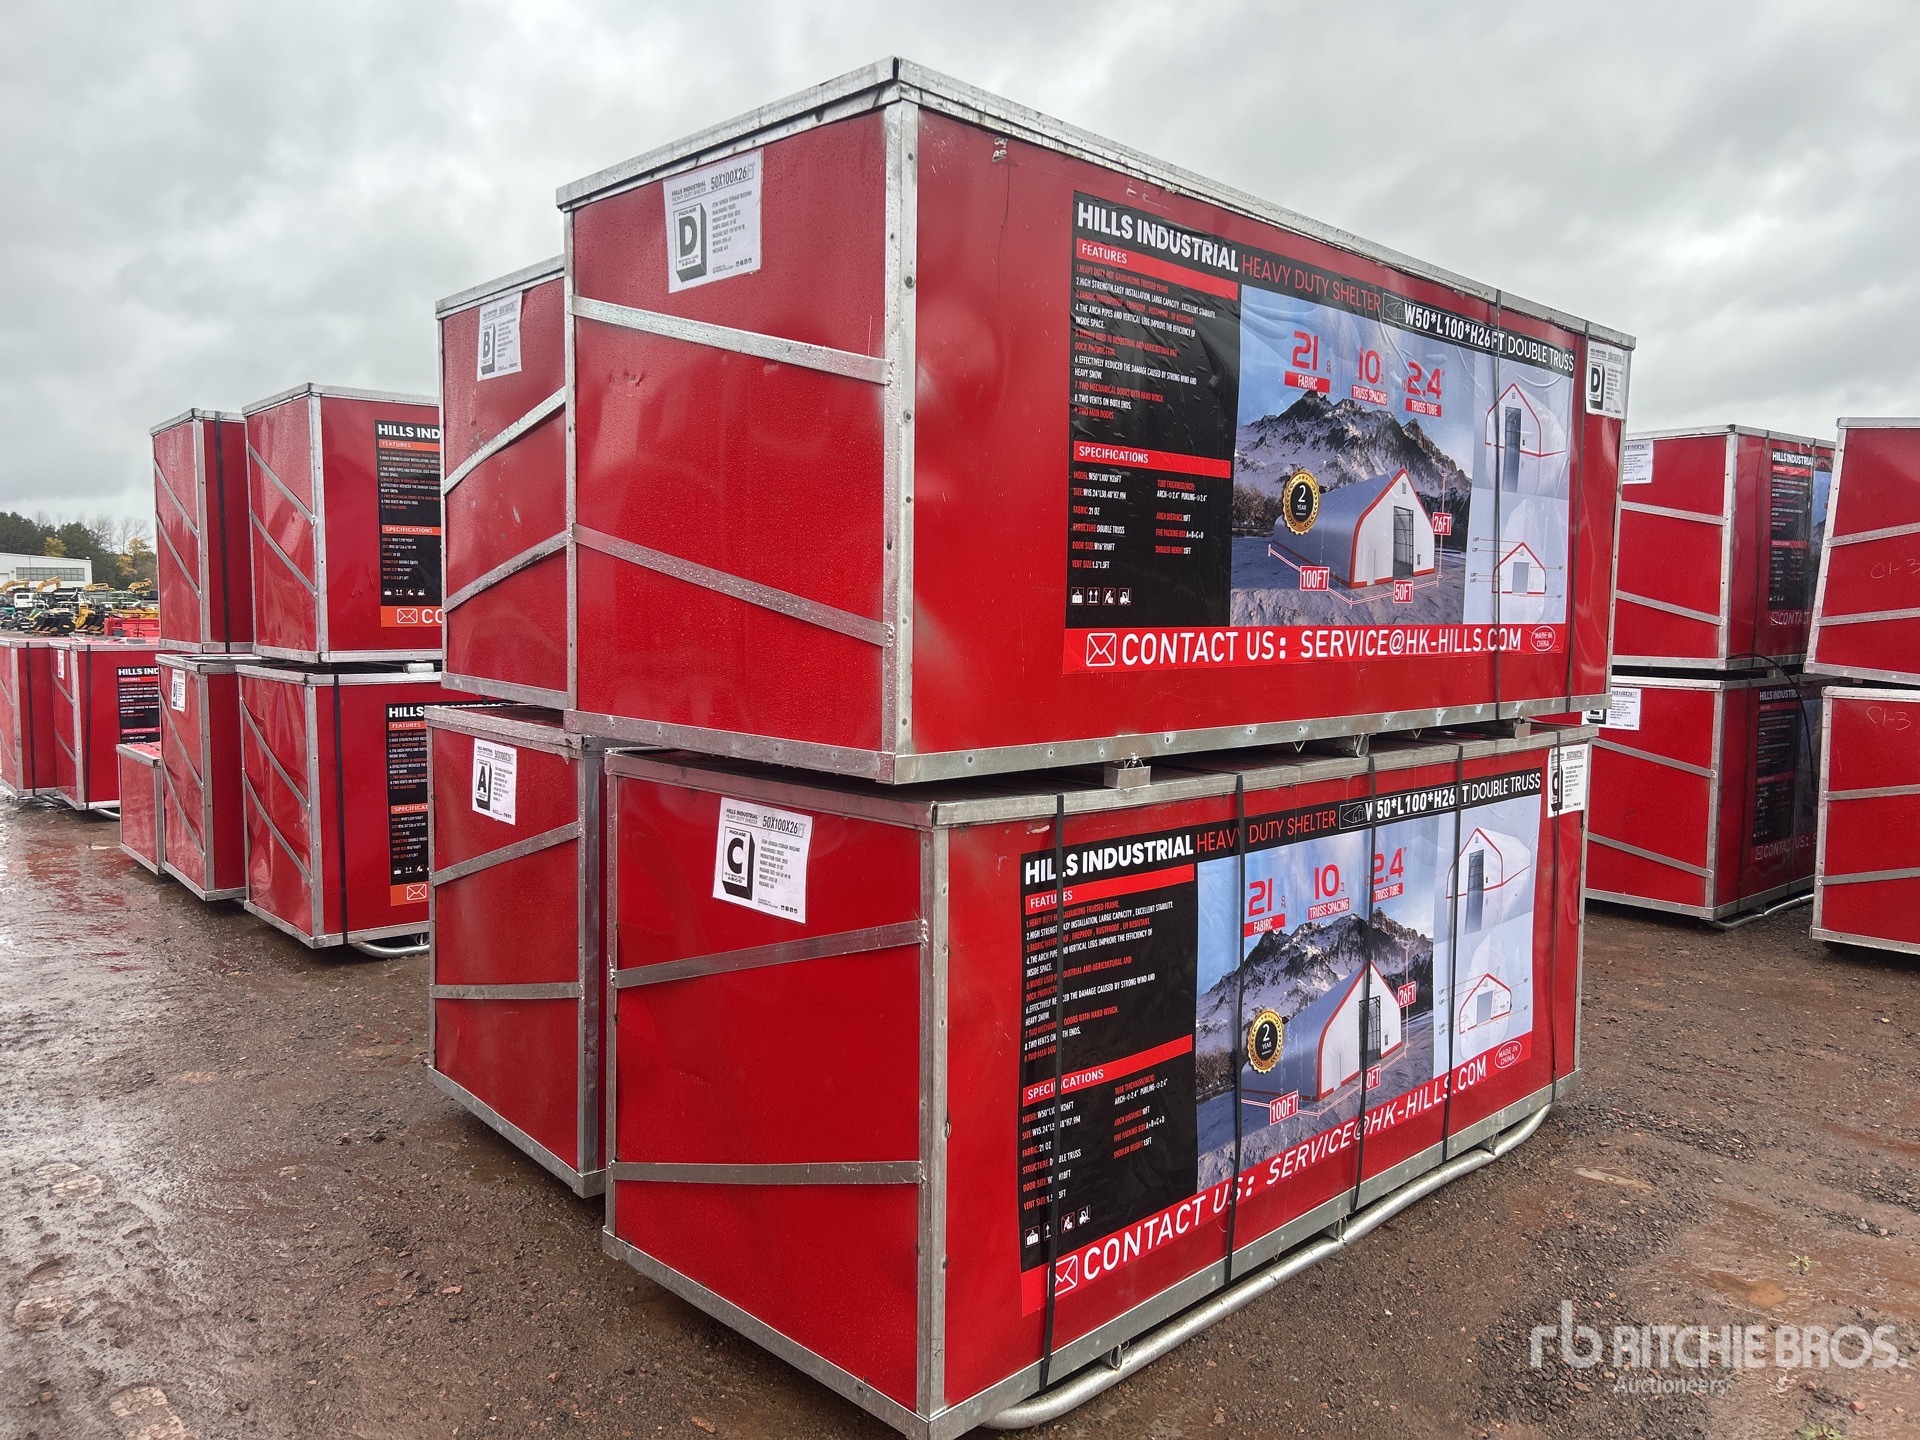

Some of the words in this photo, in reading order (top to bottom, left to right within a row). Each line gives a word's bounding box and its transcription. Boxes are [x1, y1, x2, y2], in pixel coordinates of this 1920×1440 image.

[679, 215, 697, 258] D
[1082, 243, 1127, 265] FEATURES
[1078, 202, 1133, 240] HILLS
[1137, 218, 1239, 273] INDUSTRIAL
[1242, 254, 1292, 286] HEAVY
[1295, 269, 1330, 297] DUTY
[1332, 281, 1381, 312] SHELTER
[1508, 335, 1548, 363] DOUBLE
[1550, 348, 1575, 372] TRUSS
[483, 331, 490, 359] B
[1292, 330, 1318, 371] 21
[1075, 367, 1089, 378] HEAVY
[1123, 362, 1131, 372] THE
[1358, 347, 1380, 384] 10
[1297, 374, 1318, 390] FABIRC
[1590, 367, 1601, 393] D
[1103, 397, 1109, 406] ON
[1352, 385, 1368, 402] TRUSS
[1368, 389, 1386, 406] SPACING
[1411, 399, 1426, 413] TRUSS
[1426, 402, 1437, 416] TUBE
[378, 424, 414, 438] HILLS
[1079, 445, 1149, 464] SPECIFICATIONS
[1772, 451, 1787, 462] HILLS
[1298, 485, 1306, 503] 2
[1433, 515, 1451, 533] 26FT
[1301, 569, 1328, 588] 100FT
[1395, 583, 1413, 601] 50FT
[1121, 631, 1238, 666] CONTACT
[1246, 630, 1287, 661] US:
[1299, 627, 1521, 659] SERVICE@HK-HILLS.COM
[1537, 640, 1550, 649] CHINA
[388, 706, 424, 718] HILLS
[477, 766, 487, 793] A
[729, 830, 746, 838] PACKAGE
[1025, 853, 1078, 885] HILS
[1082, 835, 1194, 874] INDUSTRIAL
[1249, 820, 1284, 844] DUTY
[1287, 810, 1337, 836] SHELTER
[1472, 778, 1508, 802] DOUBLE
[1510, 772, 1541, 794] TRUSS
[727, 838, 744, 874] C
[1314, 864, 1340, 900] 10
[1030, 891, 1073, 910] FEATUES
[1248, 878, 1273, 917] 21
[1375, 887, 1389, 901] TRUSS
[1389, 884, 1400, 898] TUBE
[1310, 905, 1327, 919] TRUSS
[1327, 899, 1349, 914] SPACING
[1098, 914, 1112, 923] LARGE
[1253, 918, 1273, 934] FABIRC
[1069, 942, 1087, 953] VERTICAL
[1087, 939, 1098, 949] LEGS
[1117, 934, 1125, 943] THE
[1147, 928, 1153, 937] OF
[1070, 991, 1078, 1000] THE
[1078, 986, 1097, 998] DAMAGE
[1097, 983, 1113, 994] CAUSED
[1114, 981, 1120, 990] BY
[1121, 978, 1136, 989] STRONG
[1137, 975, 1147, 984] WIND
[1399, 984, 1415, 1006] 26FT
[1025, 1016, 1038, 1027] HEAVY
[1038, 1035, 1049, 1046] VENTS
[1050, 1032, 1056, 1042] ON
[1263, 1023, 1270, 1042] 2
[1262, 1041, 1272, 1050] YEAR
[1498, 1047, 1512, 1058] MADE
[1500, 1054, 1514, 1065] CHINA
[1271, 1094, 1297, 1121] 100FT
[1067, 1148, 1082, 1161] TRUSS
[1023, 1181, 1036, 1192] DOOR
[1024, 1199, 1035, 1211] VENT
[1083, 1195, 1206, 1281] CONTACT
